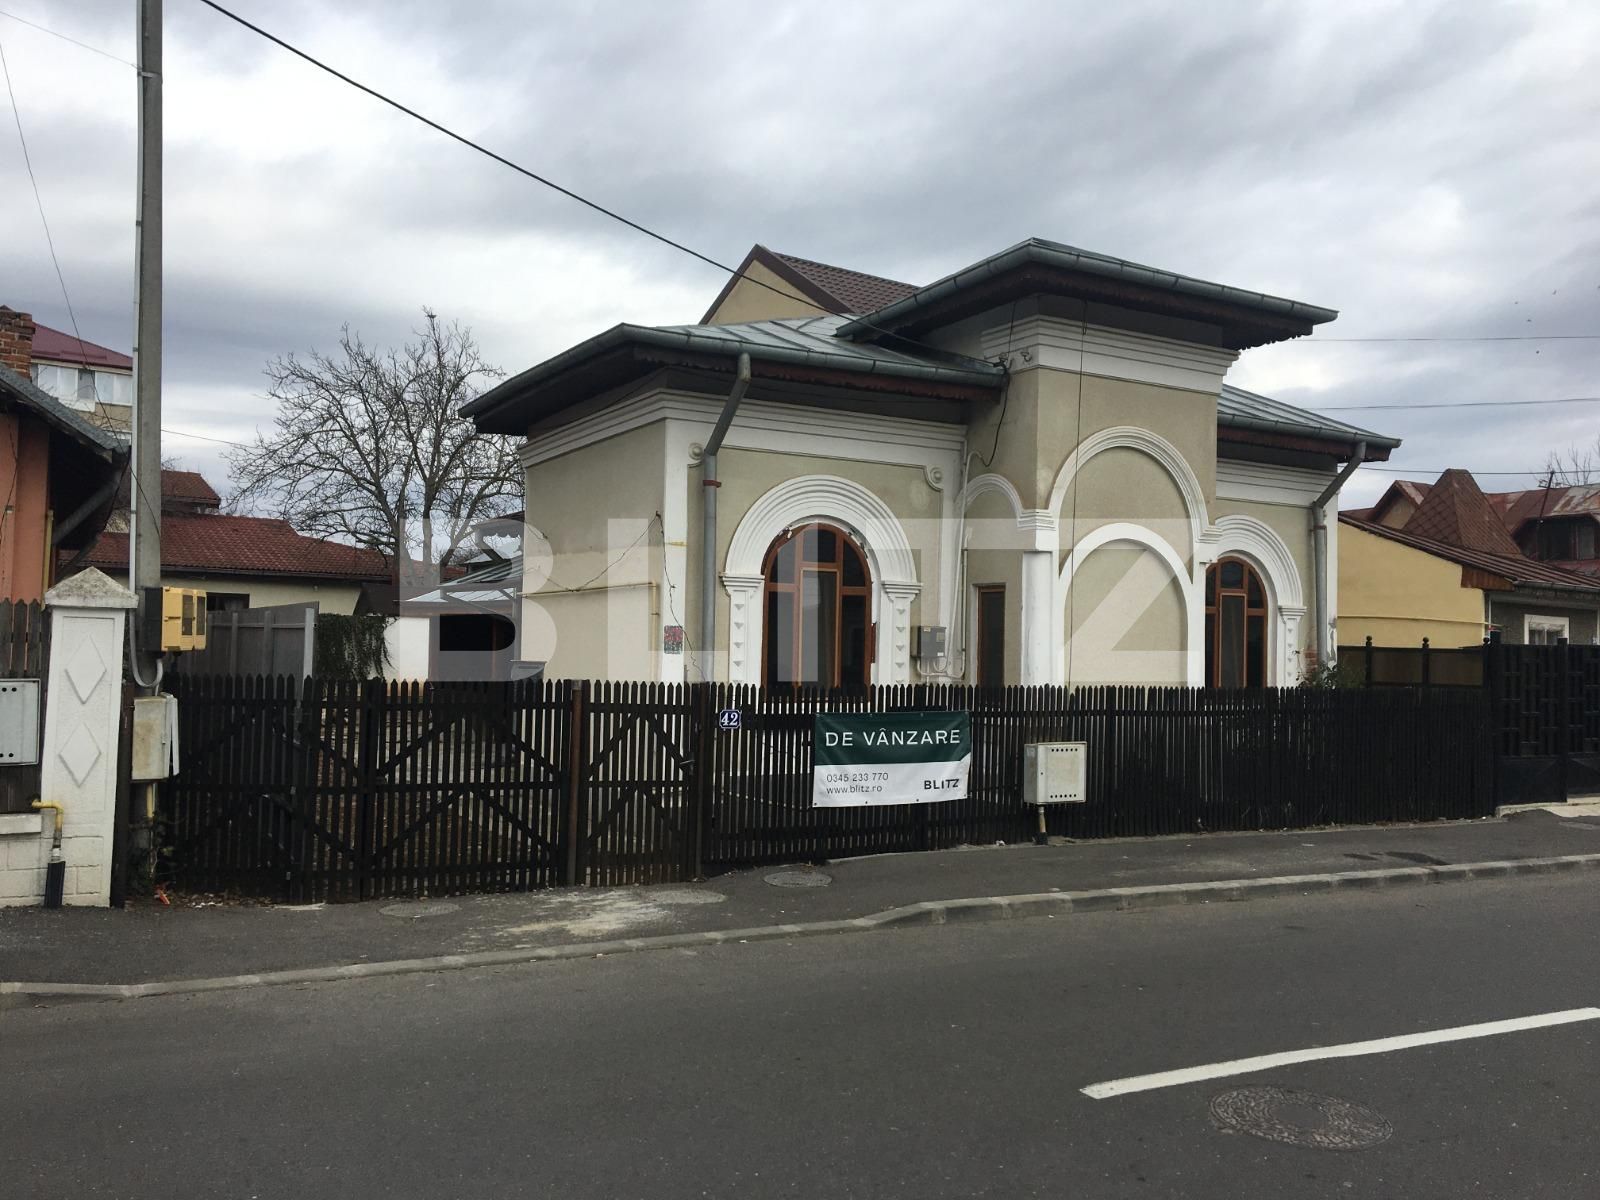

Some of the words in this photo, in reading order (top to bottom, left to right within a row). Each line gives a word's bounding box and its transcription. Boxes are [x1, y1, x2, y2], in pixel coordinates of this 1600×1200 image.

[721, 712, 739, 726] 42
[825, 731, 854, 747] DE
[862, 727, 961, 746] VÂNZARE
[826, 773, 849, 783] 0345
[852, 773, 869, 782] 233
[872, 772, 889, 781] 770
[826, 785, 883, 795] www.blitz.ro
[923, 778, 960, 790] BLITZ
